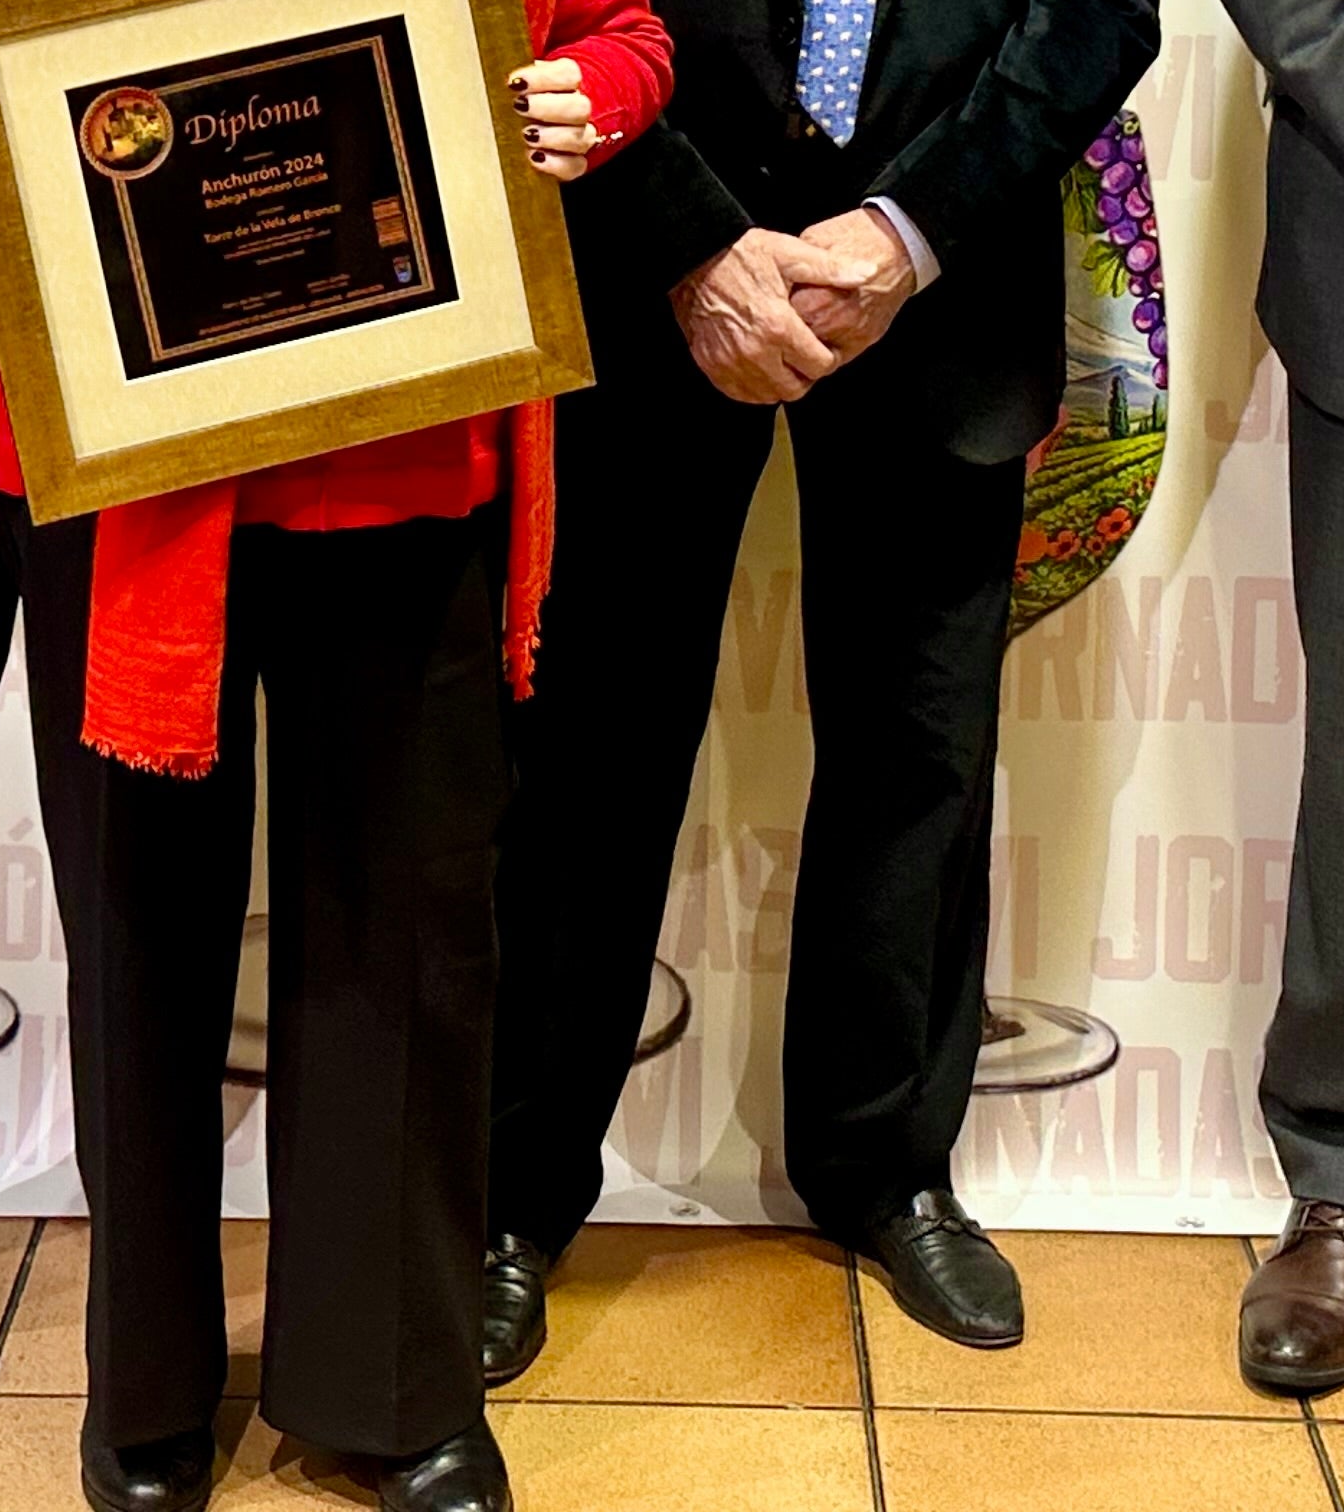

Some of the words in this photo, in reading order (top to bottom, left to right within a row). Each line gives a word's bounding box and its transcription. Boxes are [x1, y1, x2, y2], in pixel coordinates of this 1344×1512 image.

[185, 94, 322, 152] Diploma
[202, 162, 281, 194] Anchurón
[283, 152, 325, 177] 2024
